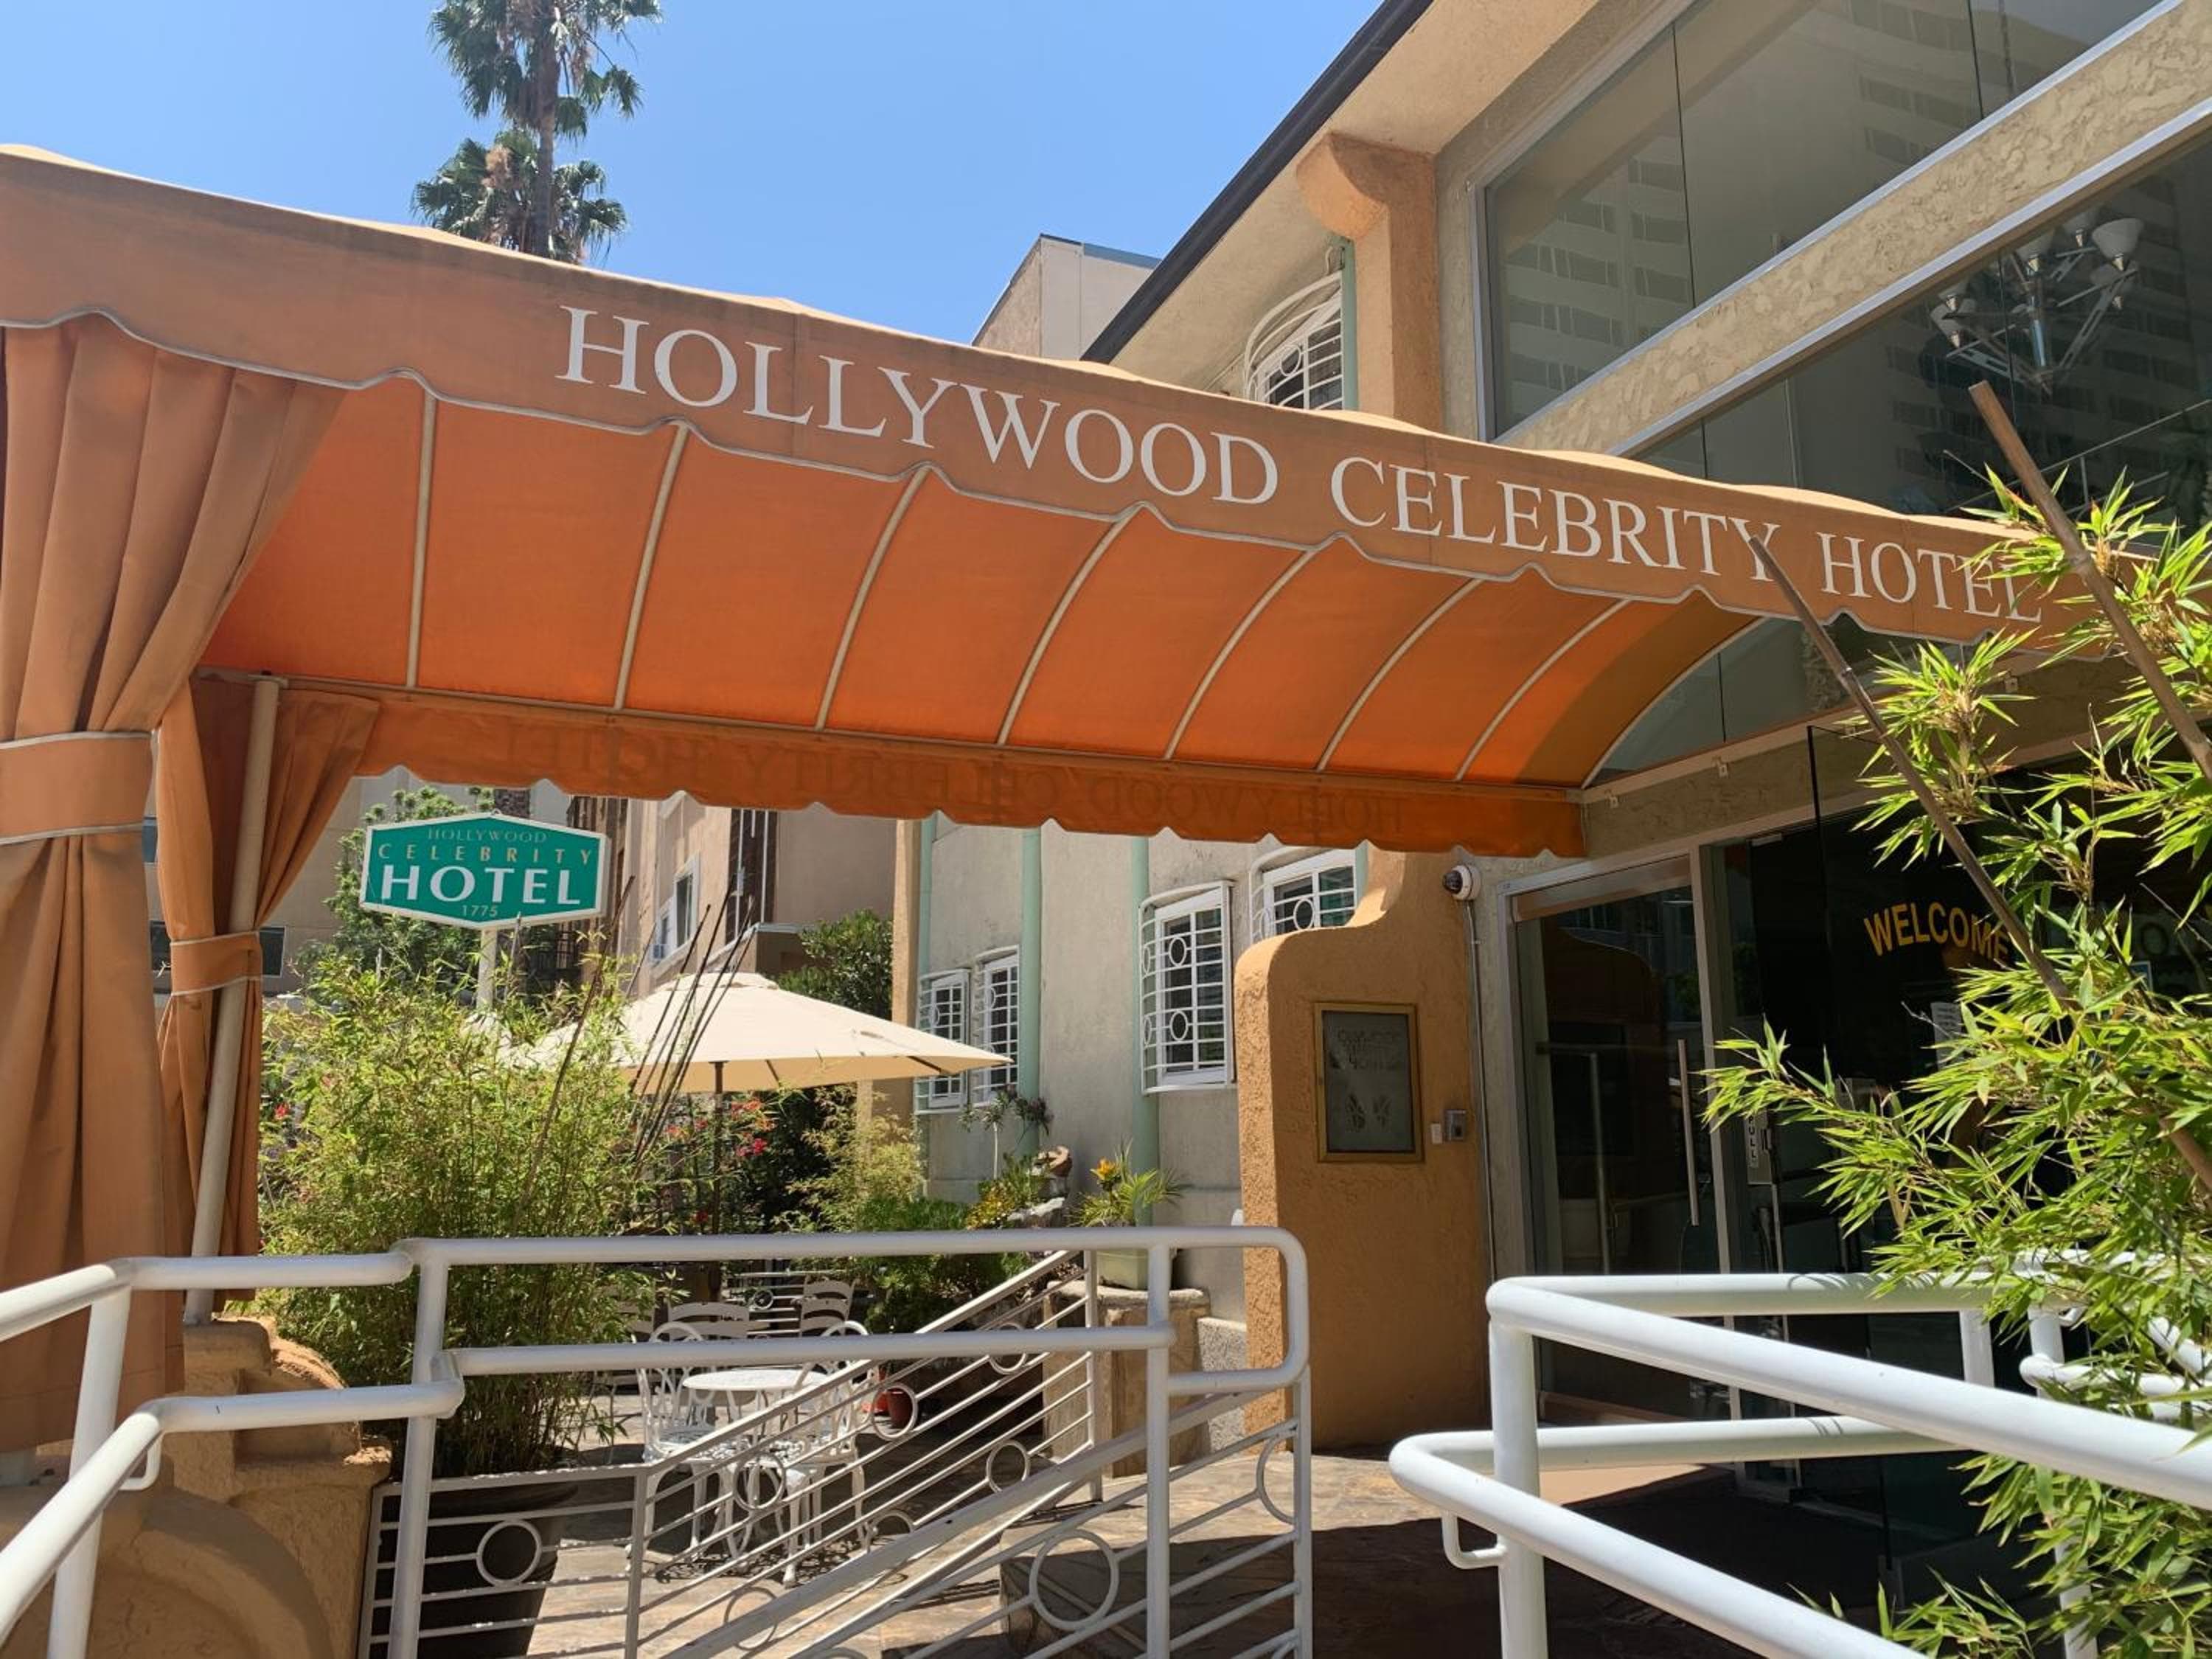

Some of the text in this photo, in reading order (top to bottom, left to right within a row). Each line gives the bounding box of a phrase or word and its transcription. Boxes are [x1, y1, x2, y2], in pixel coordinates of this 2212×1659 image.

[554, 305, 2042, 623] HOLLYWOOD CELEBRITY HOTEL
[378, 844, 593, 866] CELEBRITY
[428, 827, 548, 843] HOLLYWOOD
[380, 864, 581, 905] HOTEL
[461, 904, 498, 918] 1775
[1863, 901, 2009, 961] WELCOME
[1748, 1116, 1757, 1158] PULL
